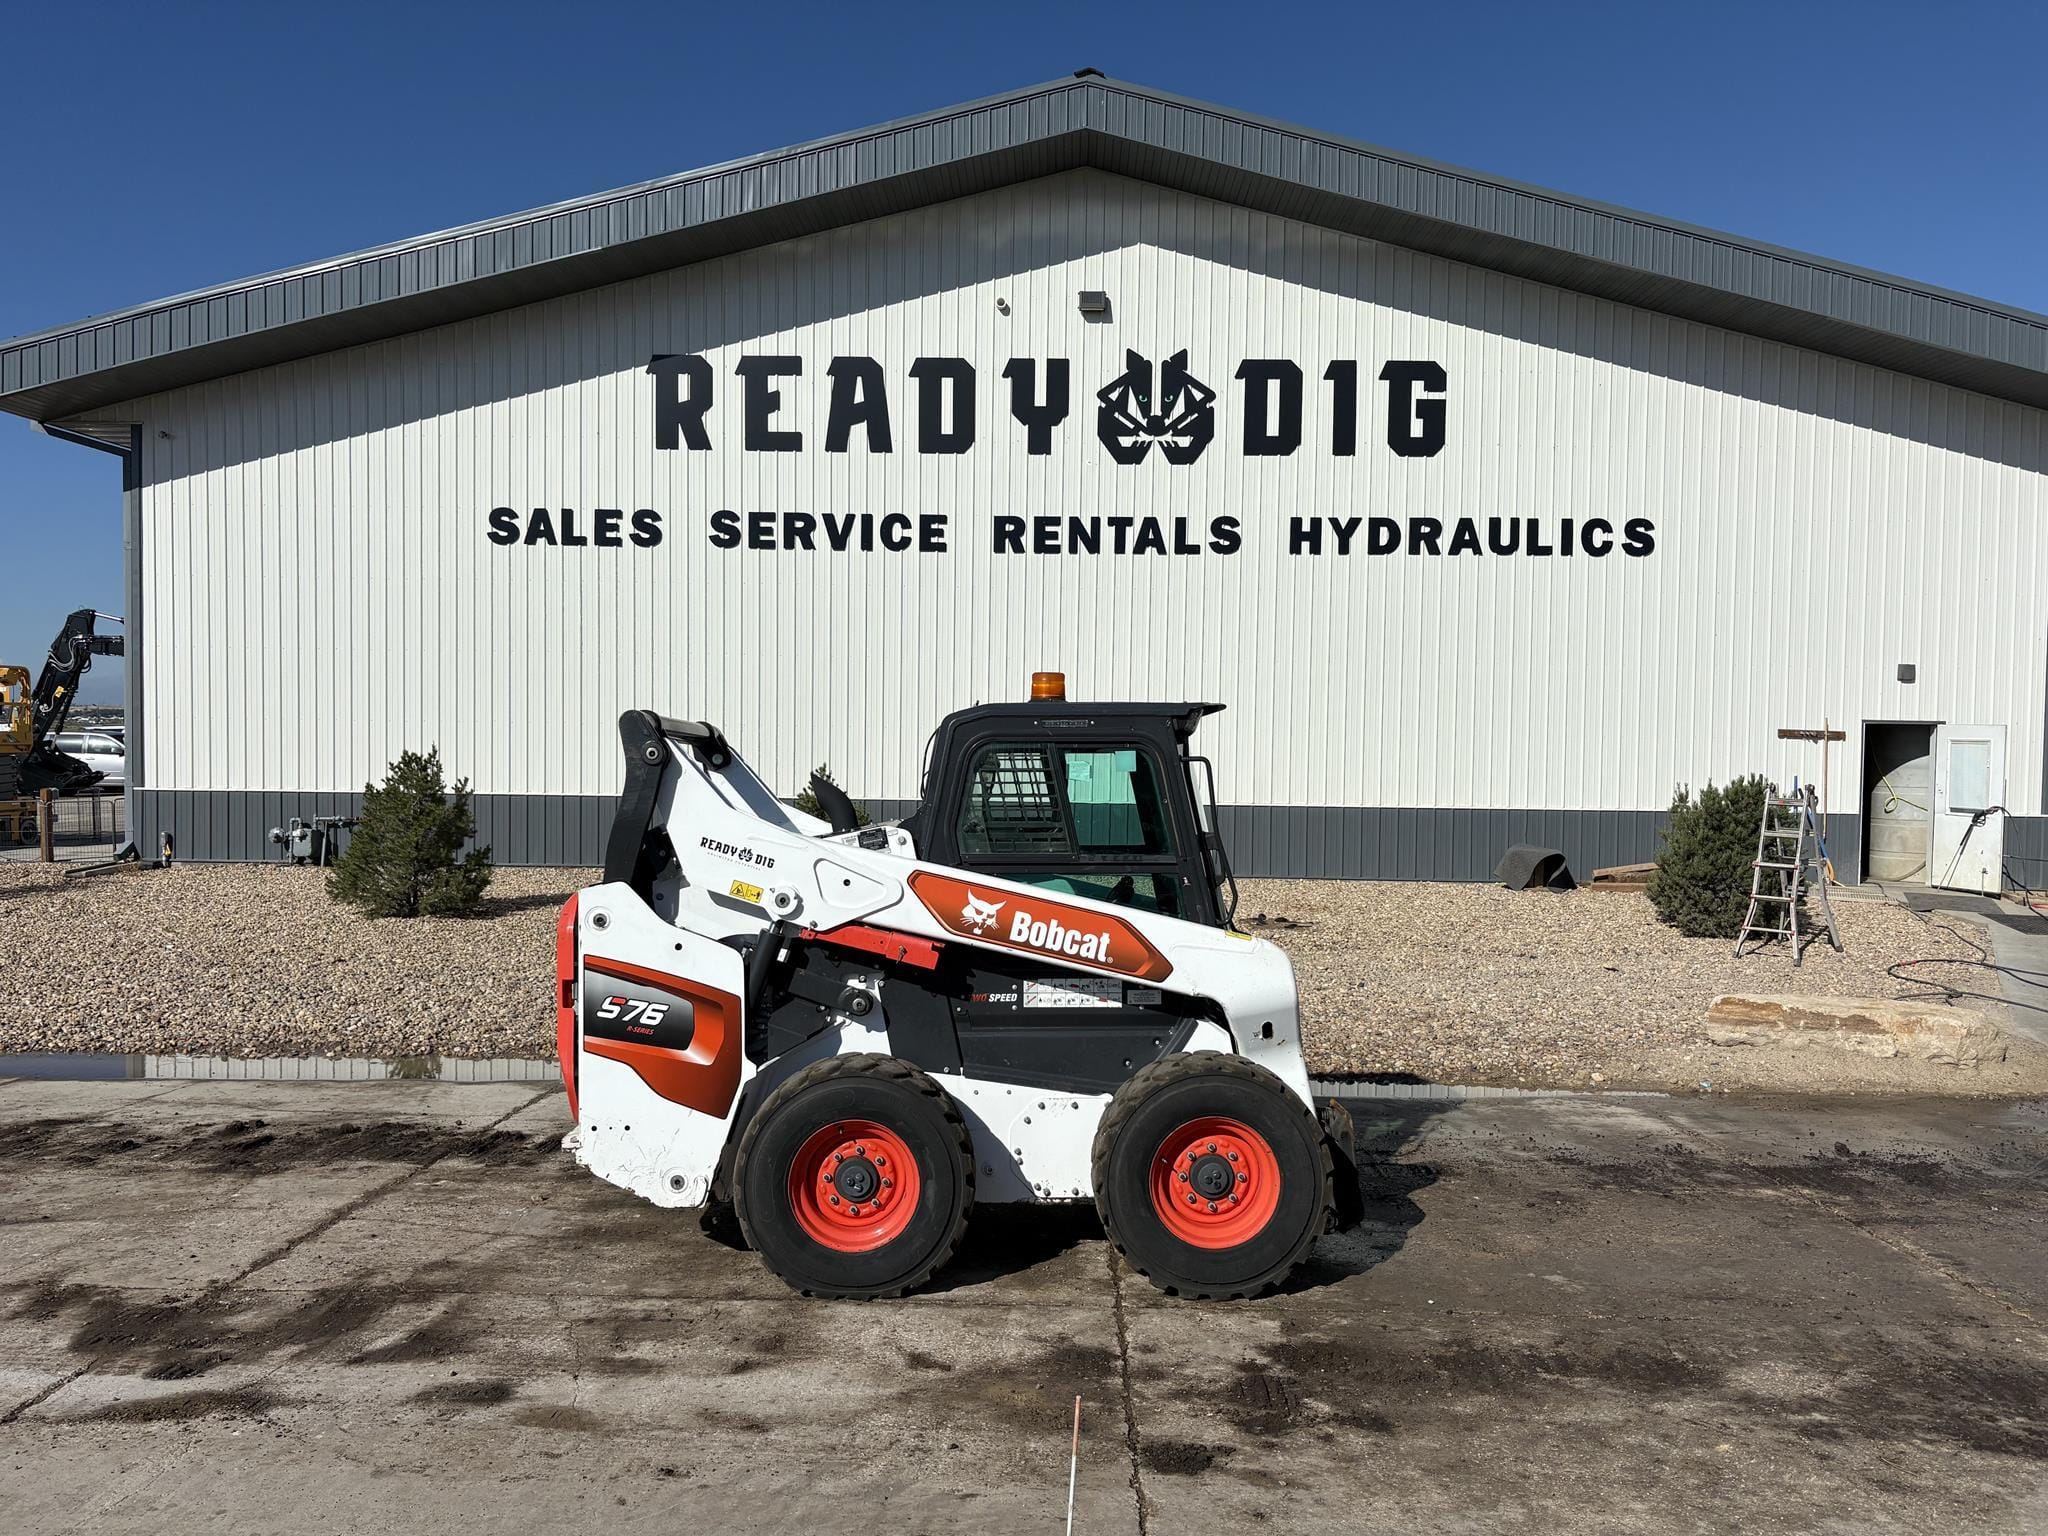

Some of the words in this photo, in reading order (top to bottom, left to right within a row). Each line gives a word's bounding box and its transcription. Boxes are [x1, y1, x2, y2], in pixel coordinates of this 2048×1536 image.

[646, 354, 1070, 455] READY
[1234, 358, 1447, 457] DIG
[487, 508, 663, 548] SALES
[709, 510, 947, 552] SERVICE
[994, 516, 1242, 555] RENTALS
[1290, 517, 1655, 557] HYDRAULICS
[700, 837, 738, 857] READY
[755, 854, 776, 869] DIG
[596, 996, 670, 1026] S76
[988, 993, 1018, 1003] SPEED
